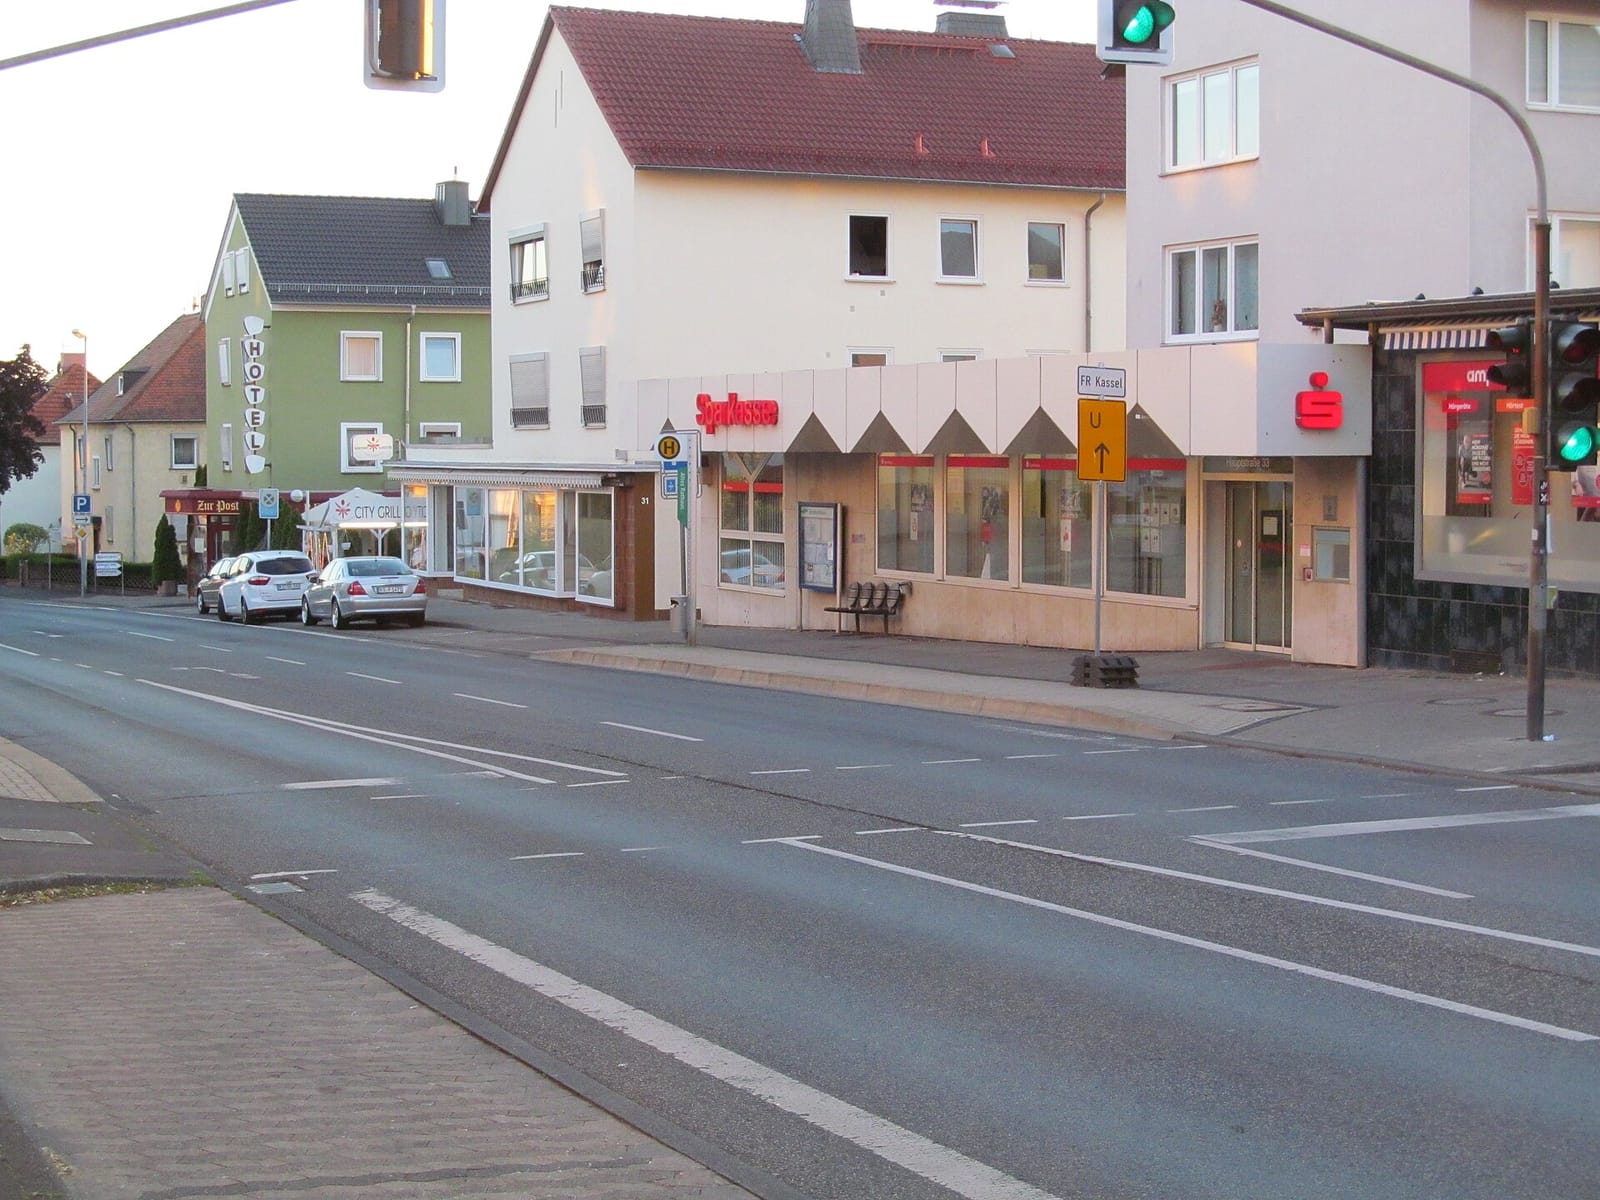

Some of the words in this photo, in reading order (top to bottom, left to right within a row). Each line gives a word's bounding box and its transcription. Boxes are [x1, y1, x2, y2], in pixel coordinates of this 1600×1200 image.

[1080, 374, 1091, 387] FR
[1095, 375, 1123, 389] Kassel
[1466, 368, 1489, 387] am
[249, 341, 262, 449] HOTEL
[695, 392, 779, 435] Sparkasse
[1090, 411, 1101, 429] U
[663, 440, 675, 455] H
[76, 497, 87, 511] P
[197, 500, 214, 511] Zur
[216, 500, 239, 512] Post
[640, 497, 649, 505] 31
[354, 505, 376, 519] CITY
[377, 505, 401, 519] GRILL
